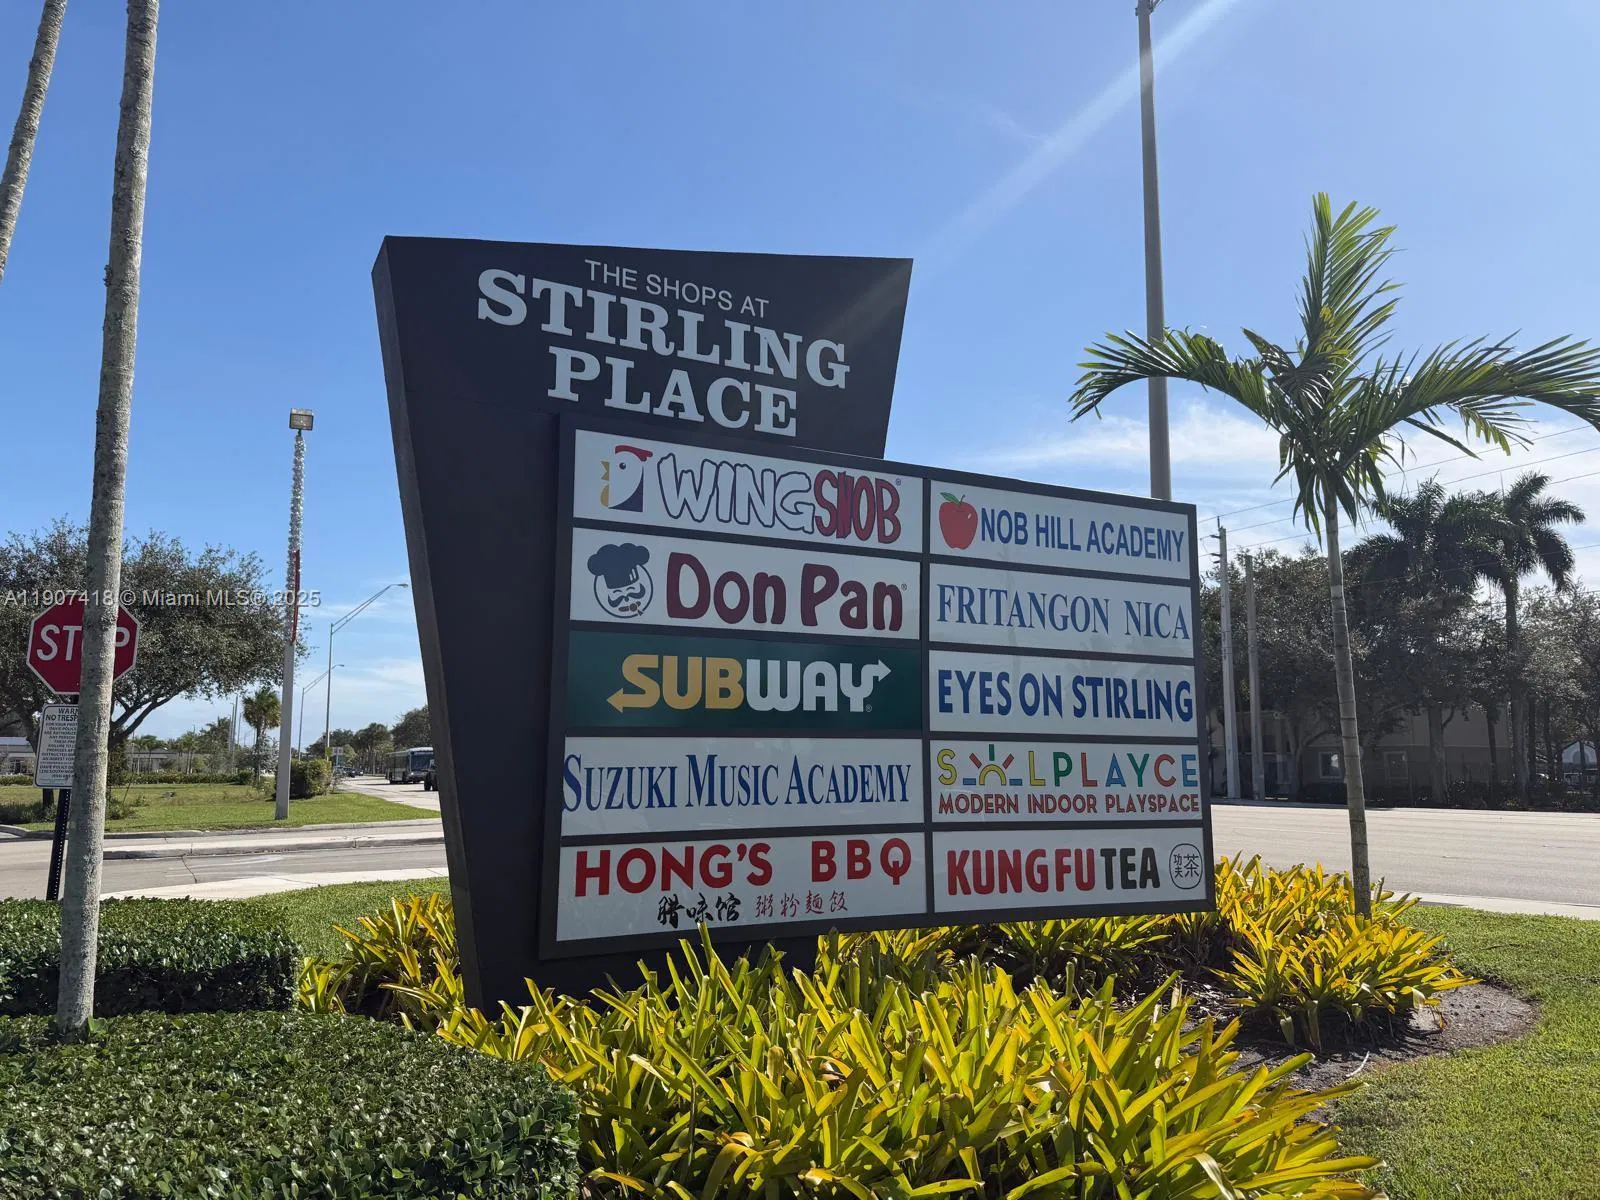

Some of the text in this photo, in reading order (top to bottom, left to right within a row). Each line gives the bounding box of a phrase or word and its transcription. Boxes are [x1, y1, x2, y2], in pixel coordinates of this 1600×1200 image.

[584, 259, 770, 318] THE SHOPS AT
[477, 268, 850, 389] STIRLING
[547, 345, 797, 437] PLACE
[981, 507, 1185, 562] NOB HILL ACADEMY
[666, 551, 786, 624] Don
[936, 583, 1191, 640] FRITANGON NICA
[36, 624, 131, 661] STP
[606, 654, 891, 713] SUBWAY
[937, 669, 1193, 722] EYES ON STIRLING
[562, 753, 912, 812] SUZUKI MUSIC ACADEMY
[938, 793, 1200, 814] MODERN INDOOR PLAYSPACE
[574, 838, 912, 898] HONG'S BBQ
[946, 847, 1161, 896] KUNG FU TEA
